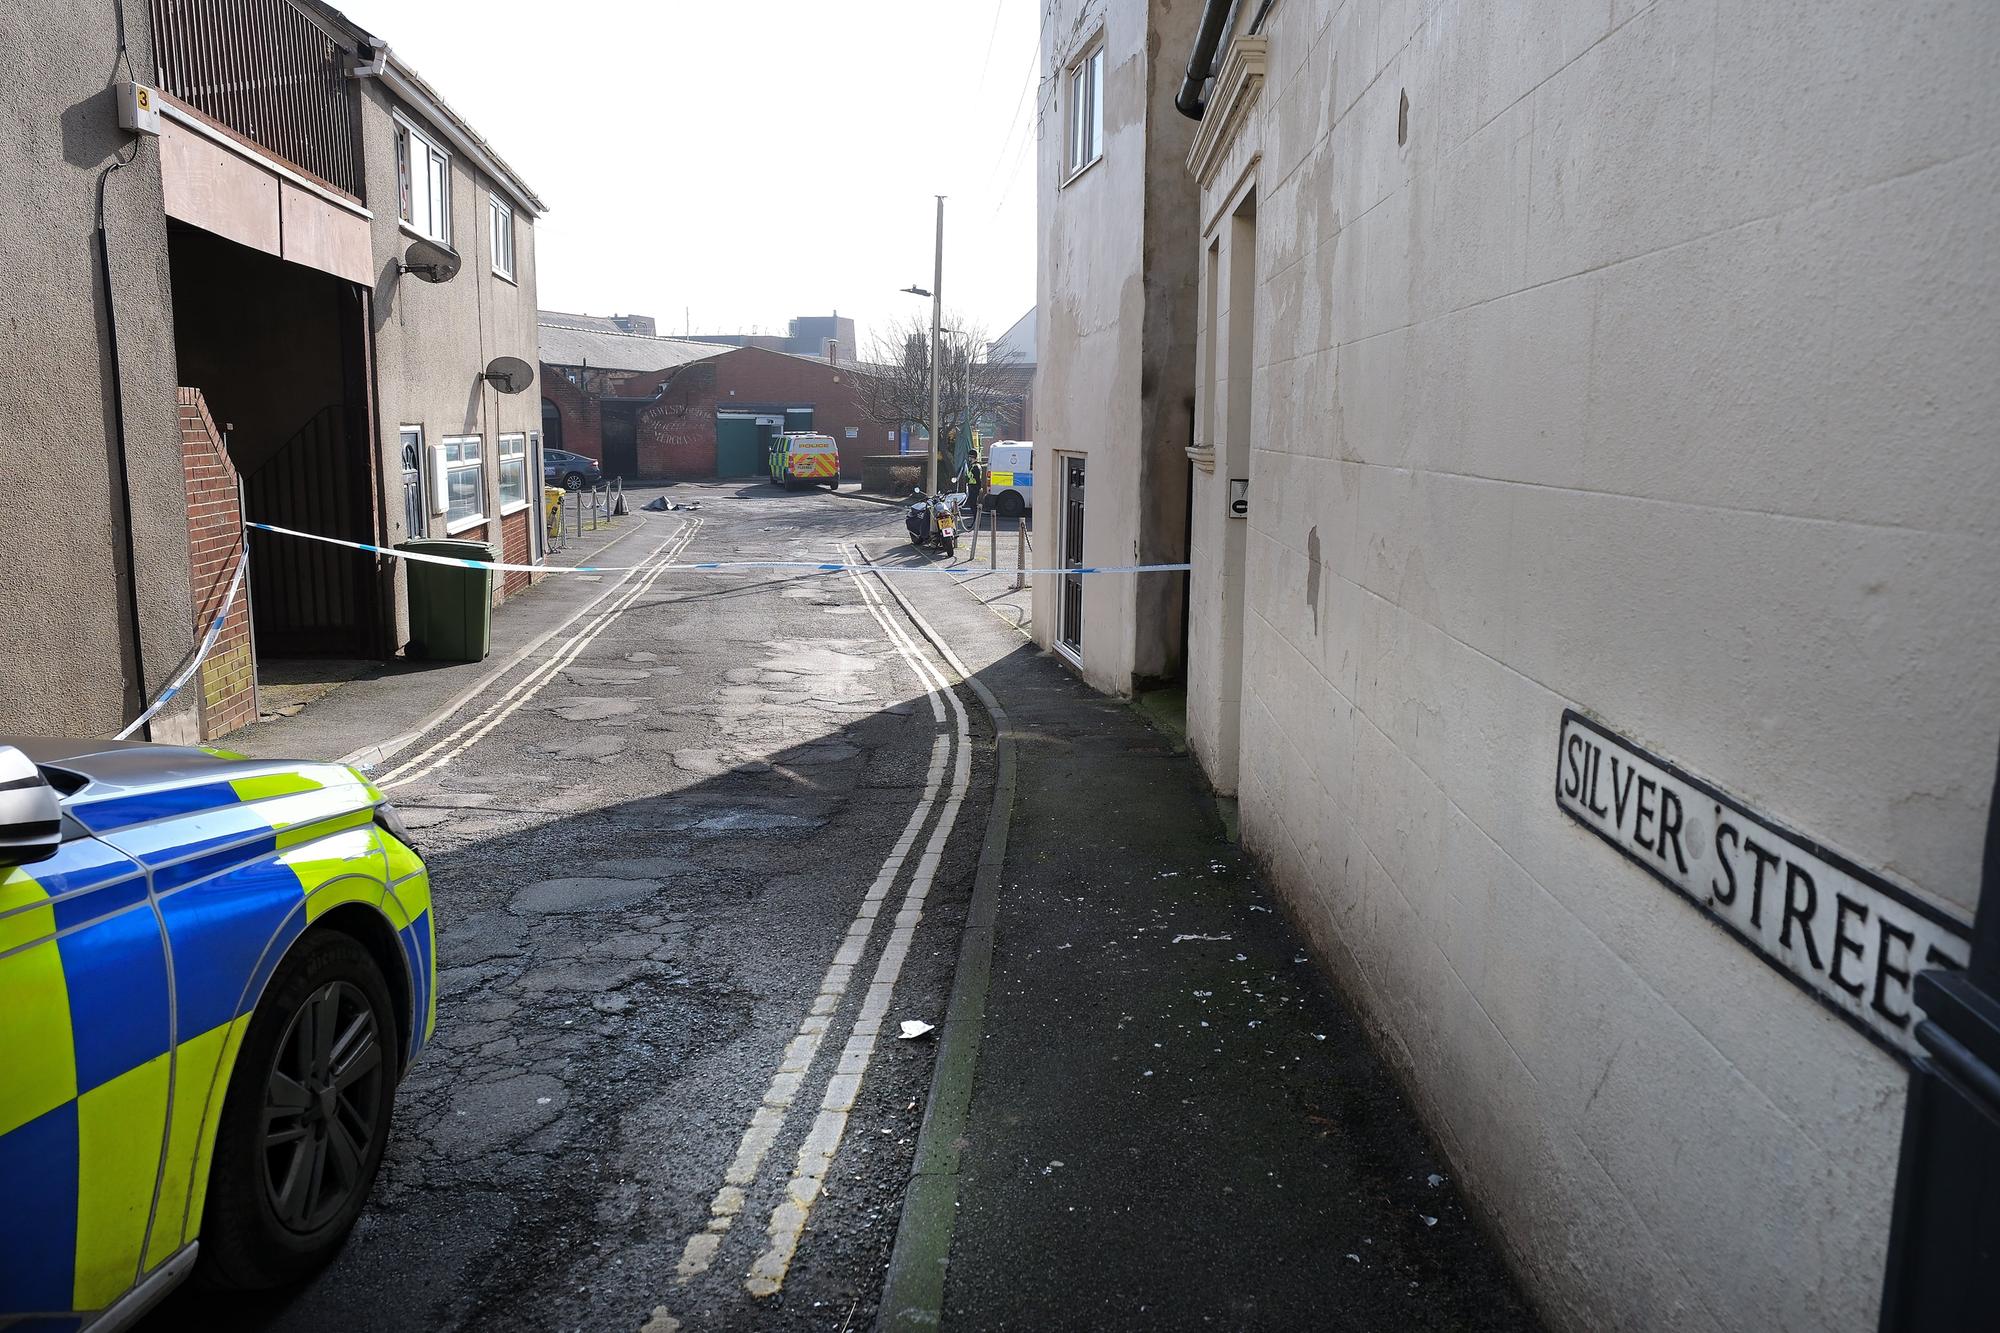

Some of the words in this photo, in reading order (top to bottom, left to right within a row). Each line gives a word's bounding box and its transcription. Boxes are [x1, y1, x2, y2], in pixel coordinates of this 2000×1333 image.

[139, 90, 147, 107] 3
[1564, 732, 1689, 874] SILVER
[1711, 822, 1970, 1029] STREE
